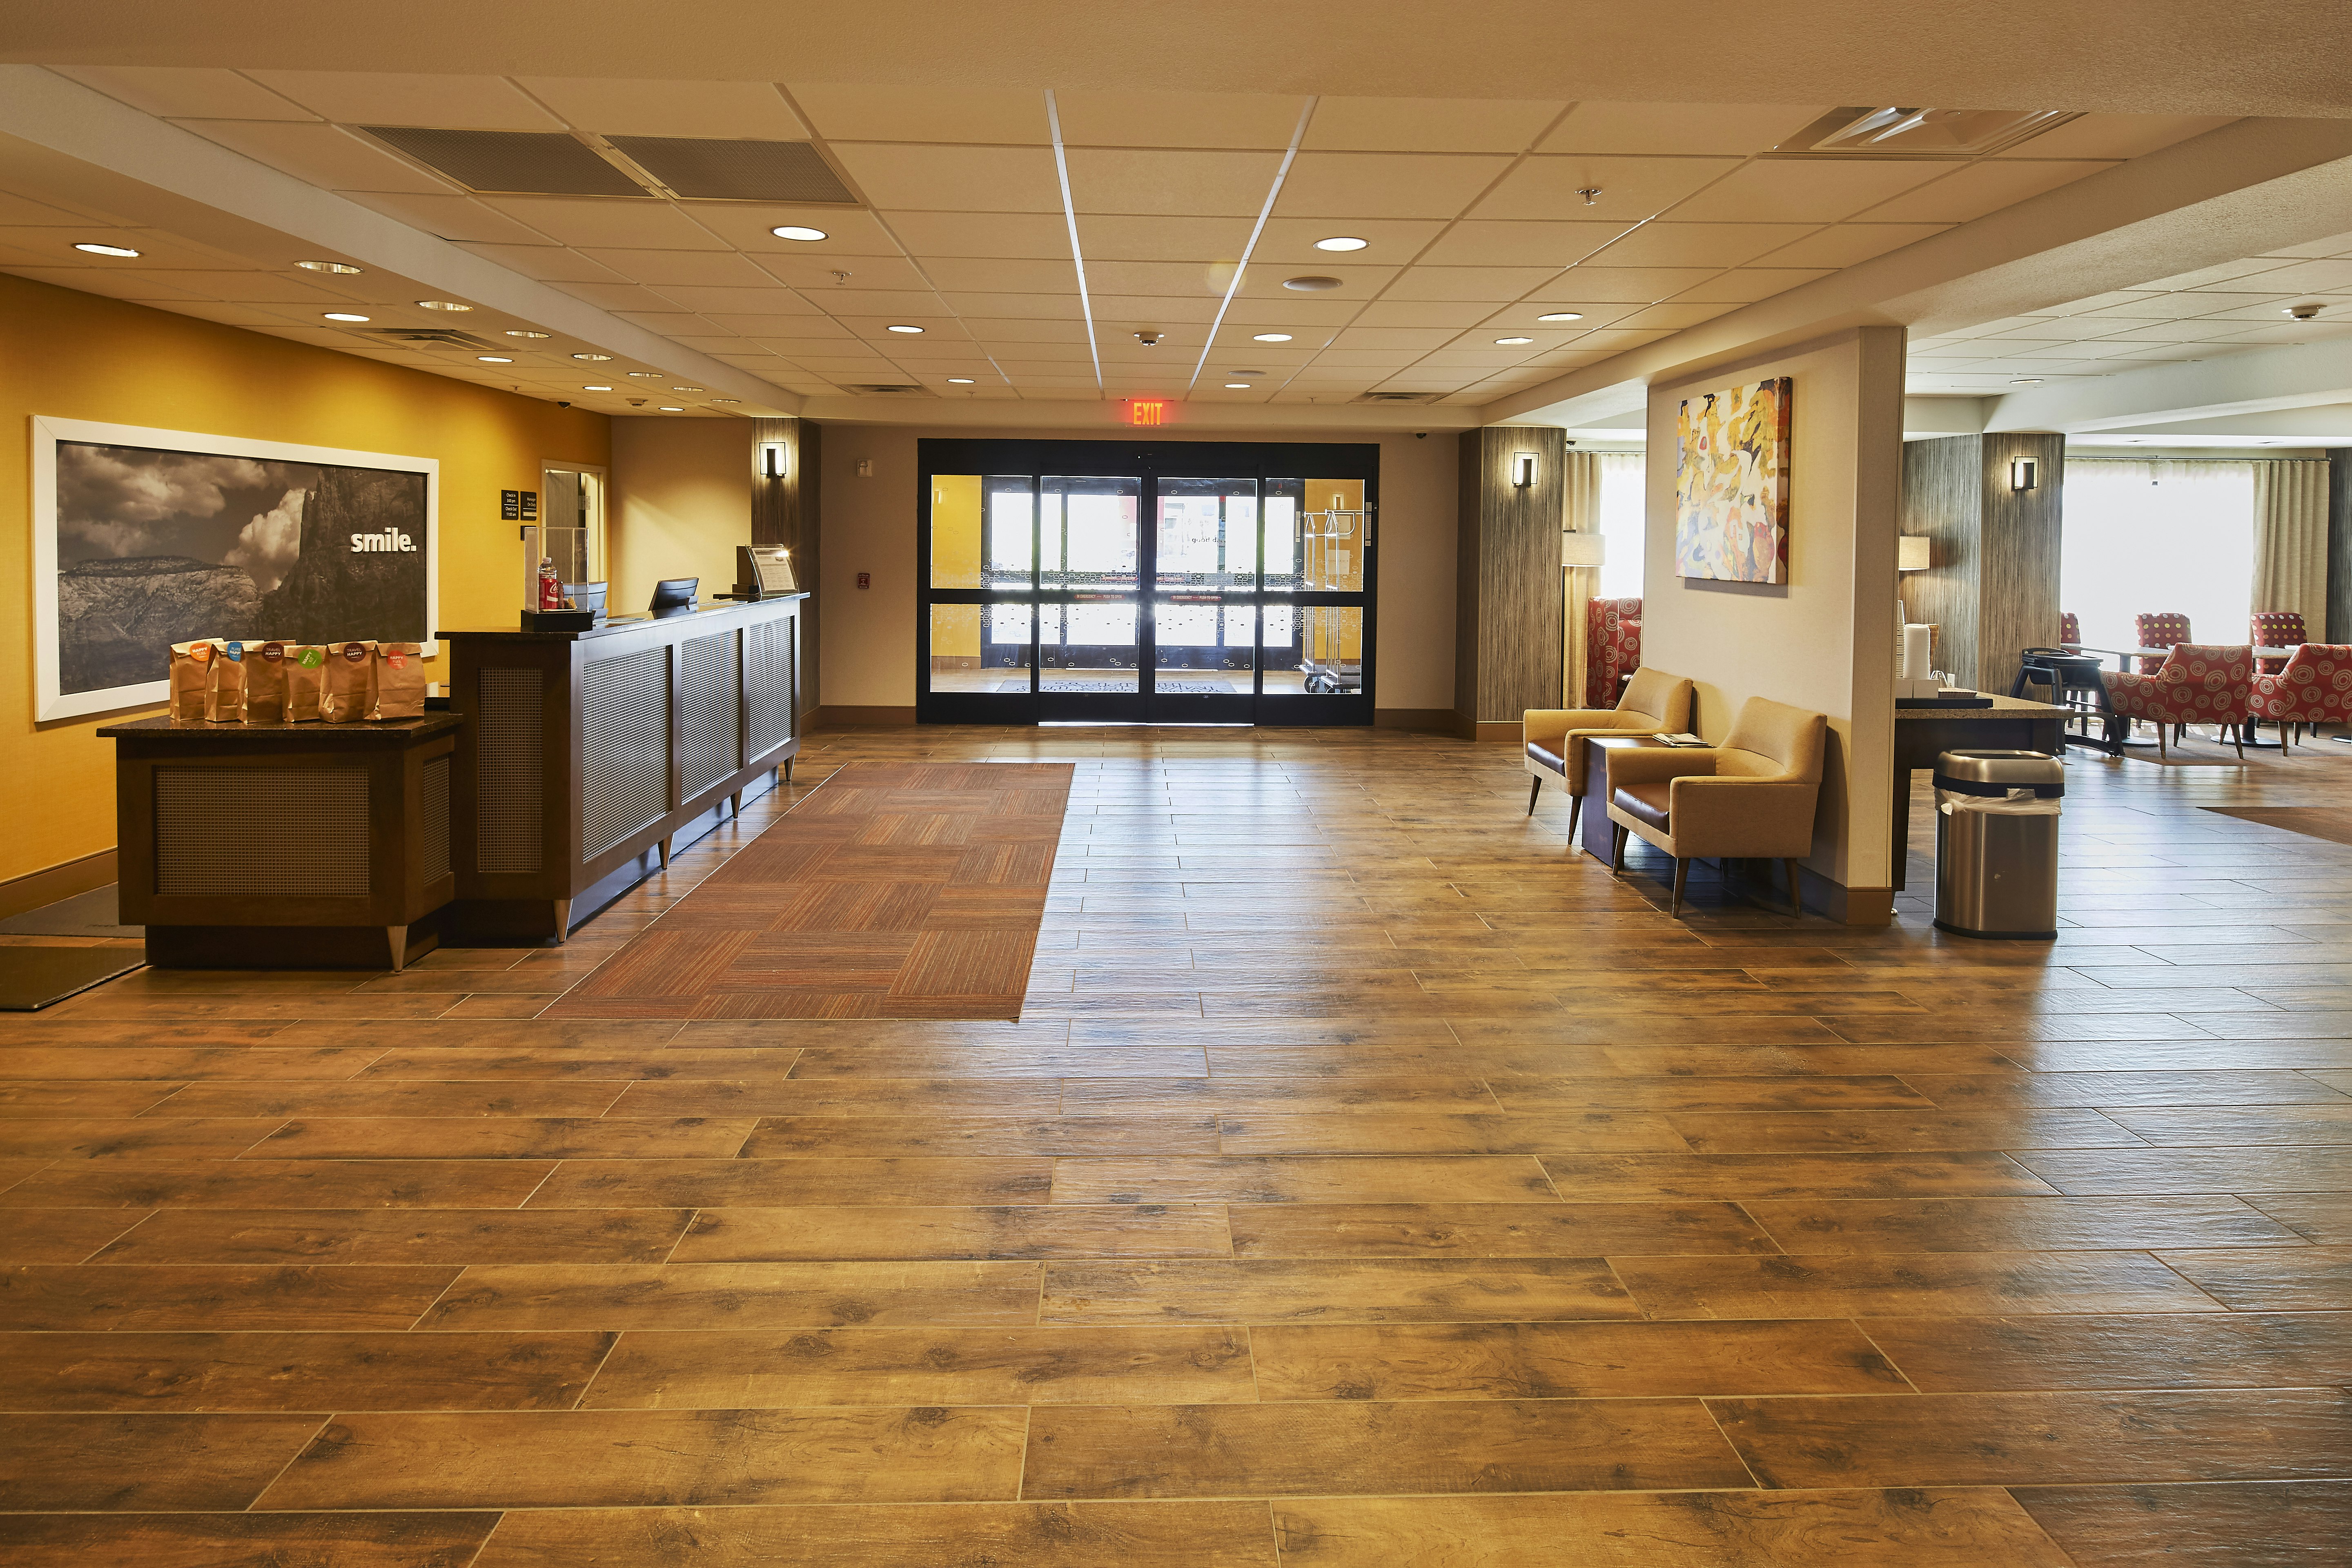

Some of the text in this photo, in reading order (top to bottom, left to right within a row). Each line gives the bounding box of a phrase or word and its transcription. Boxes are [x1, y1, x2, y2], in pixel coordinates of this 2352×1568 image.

[1134, 403, 1163, 425] EXIT
[350, 527, 417, 552] smile.
[302, 651, 312, 664] HAPPY
